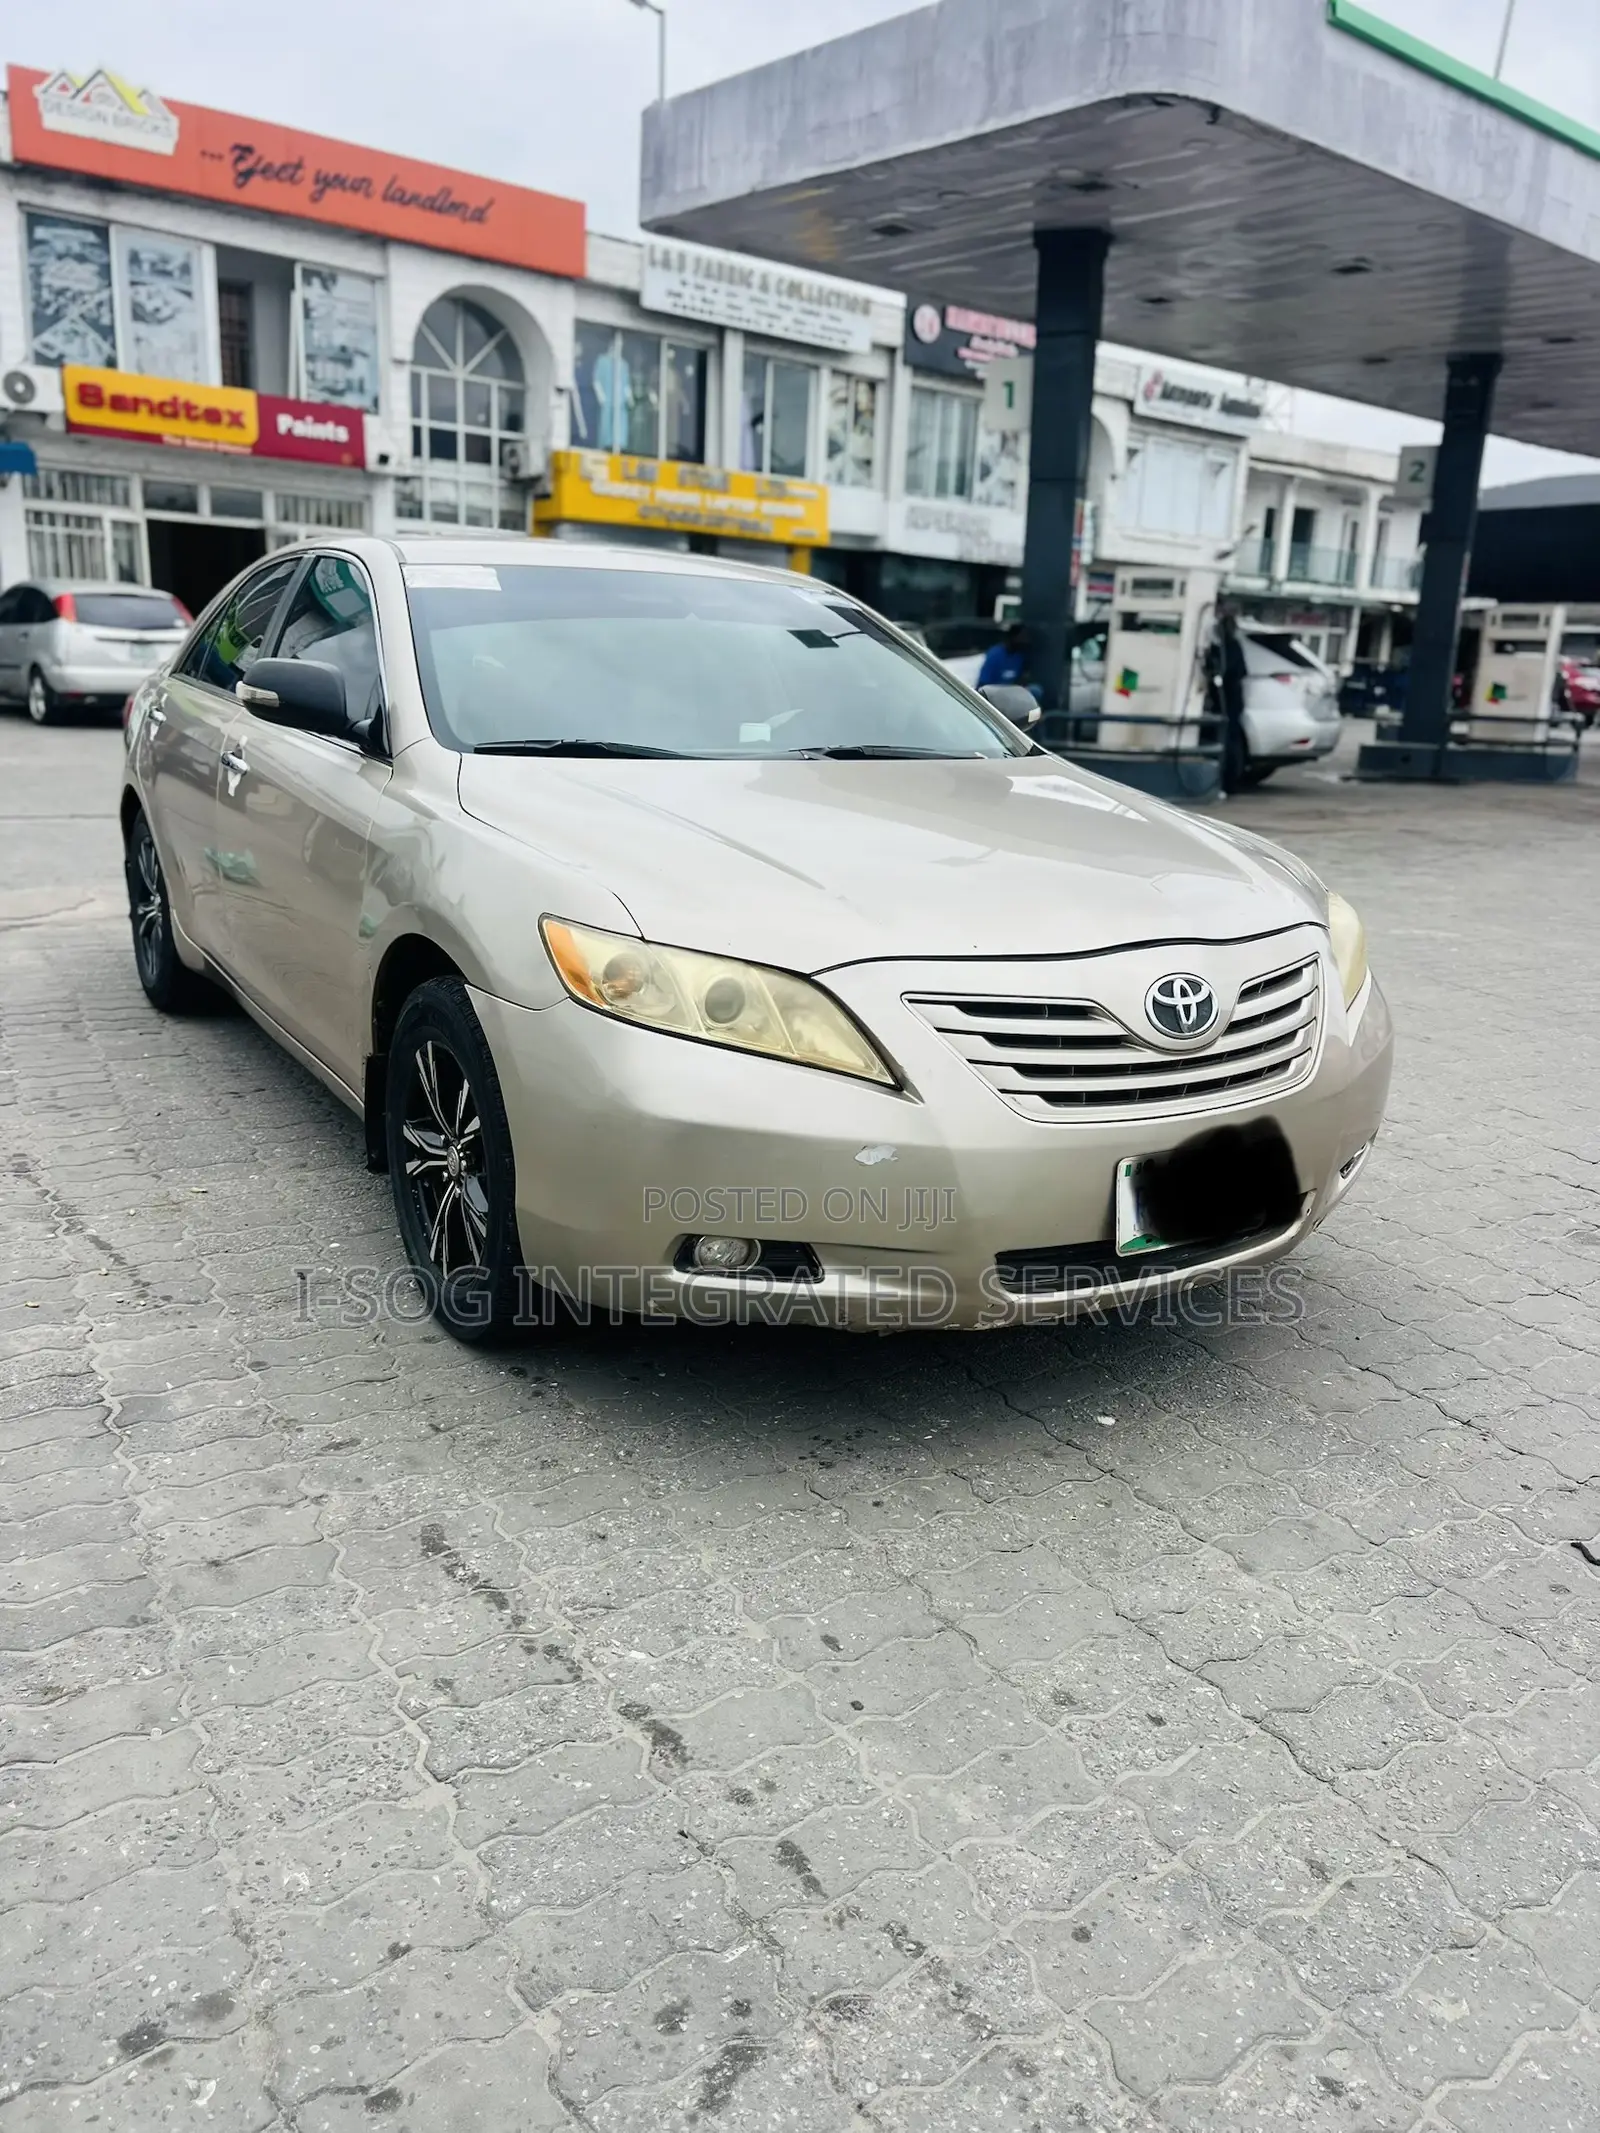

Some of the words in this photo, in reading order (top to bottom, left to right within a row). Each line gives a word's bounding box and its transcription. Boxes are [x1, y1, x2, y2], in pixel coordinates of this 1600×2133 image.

[311, 167, 373, 204] your
[1003, 380, 1015, 409] 1
[276, 412, 350, 444] Paints
[1409, 460, 1425, 482] 2
